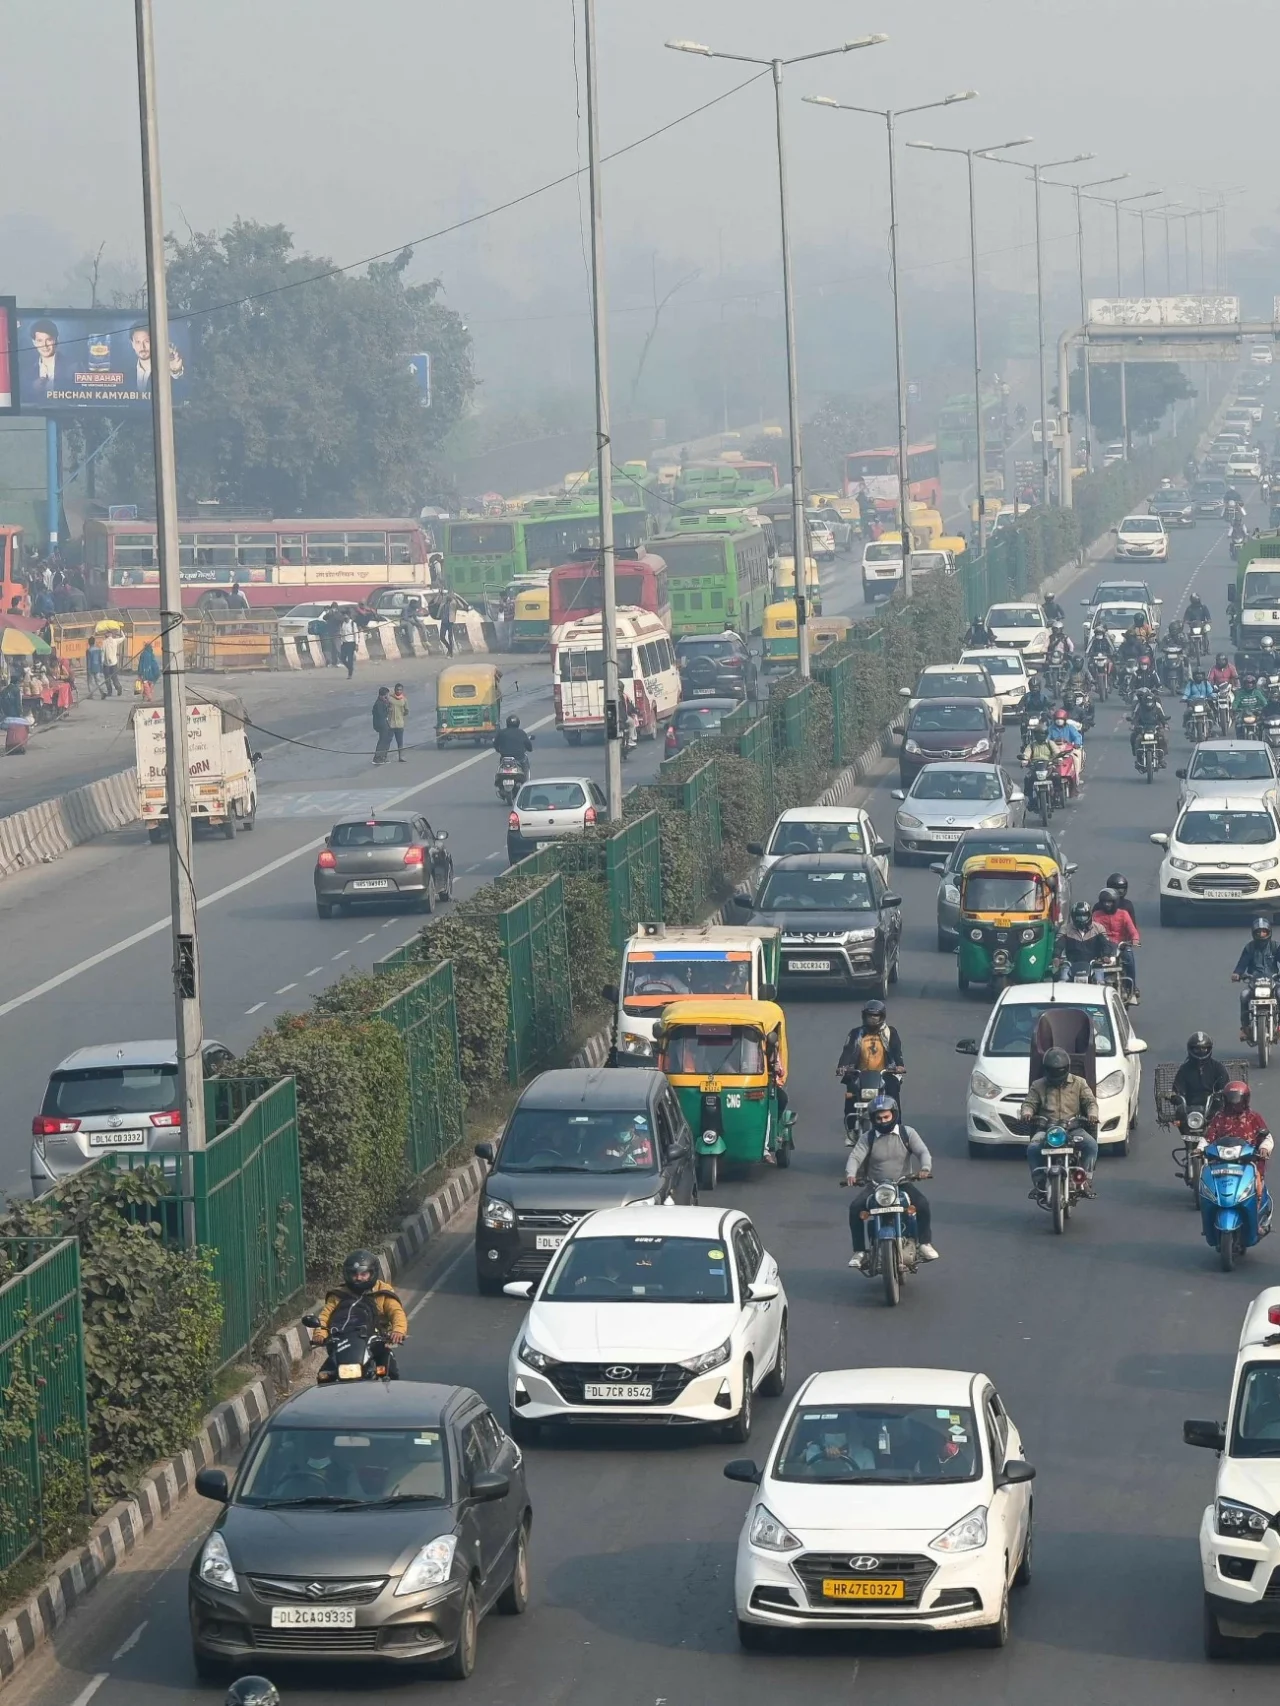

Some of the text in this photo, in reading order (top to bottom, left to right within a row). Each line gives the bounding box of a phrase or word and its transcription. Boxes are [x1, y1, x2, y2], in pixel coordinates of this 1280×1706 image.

[76, 374, 121, 382] PAN BAHAR
[47, 391, 151, 399] PEHCHAN KAMYABI KI
[149, 766, 166, 777] BLO
[726, 1094, 741, 1108] CNG
[542, 1239, 553, 1247] DL
[591, 1387, 651, 1397] DL 7CR 8542
[833, 1583, 898, 1595] HR47E0327
